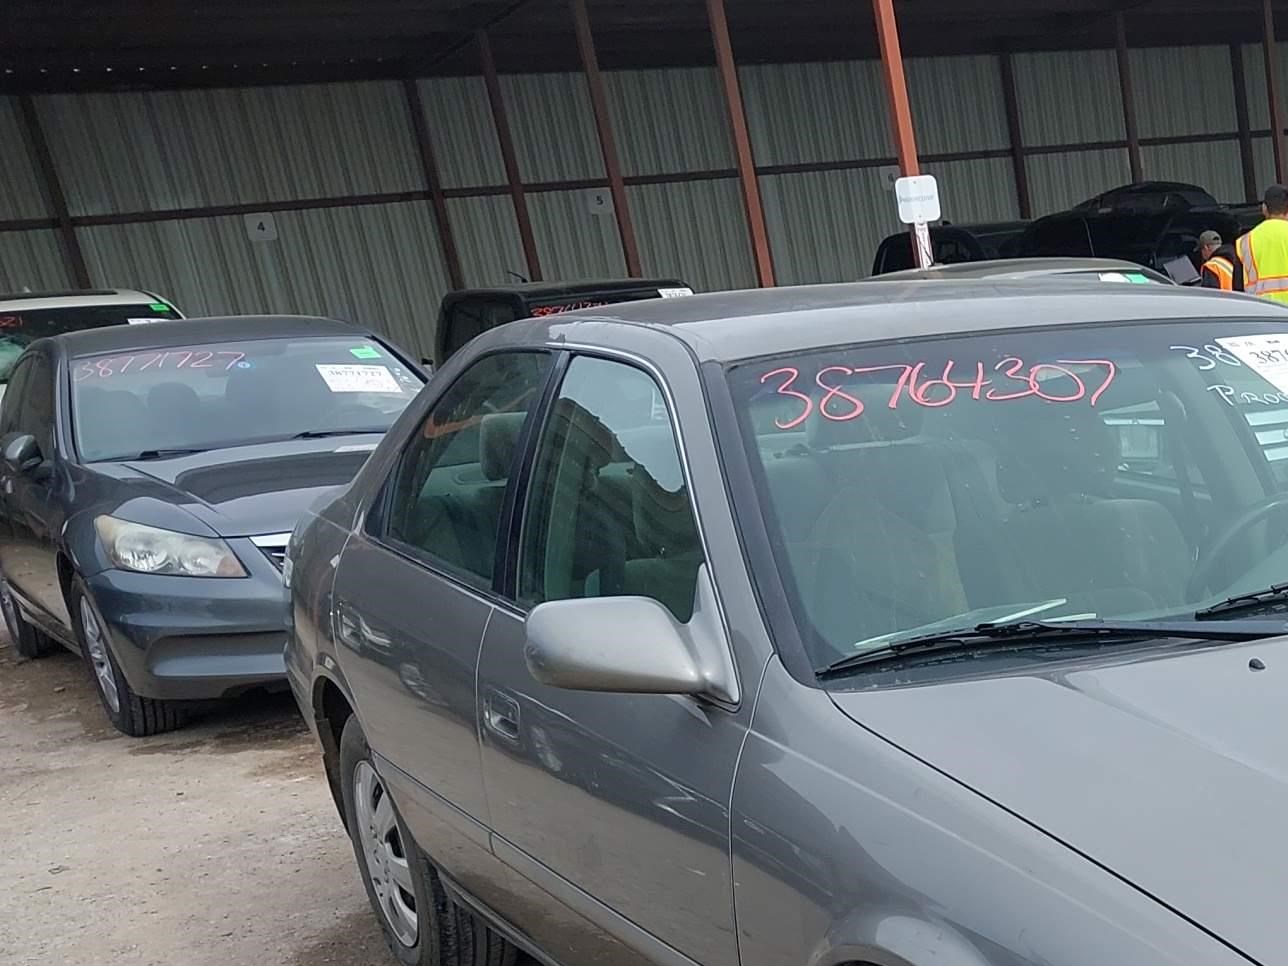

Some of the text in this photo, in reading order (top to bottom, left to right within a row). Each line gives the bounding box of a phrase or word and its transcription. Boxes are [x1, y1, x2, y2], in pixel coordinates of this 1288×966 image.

[595, 195, 604, 206] 5
[256, 221, 266, 232] 4
[760, 357, 1116, 430] 38764307
